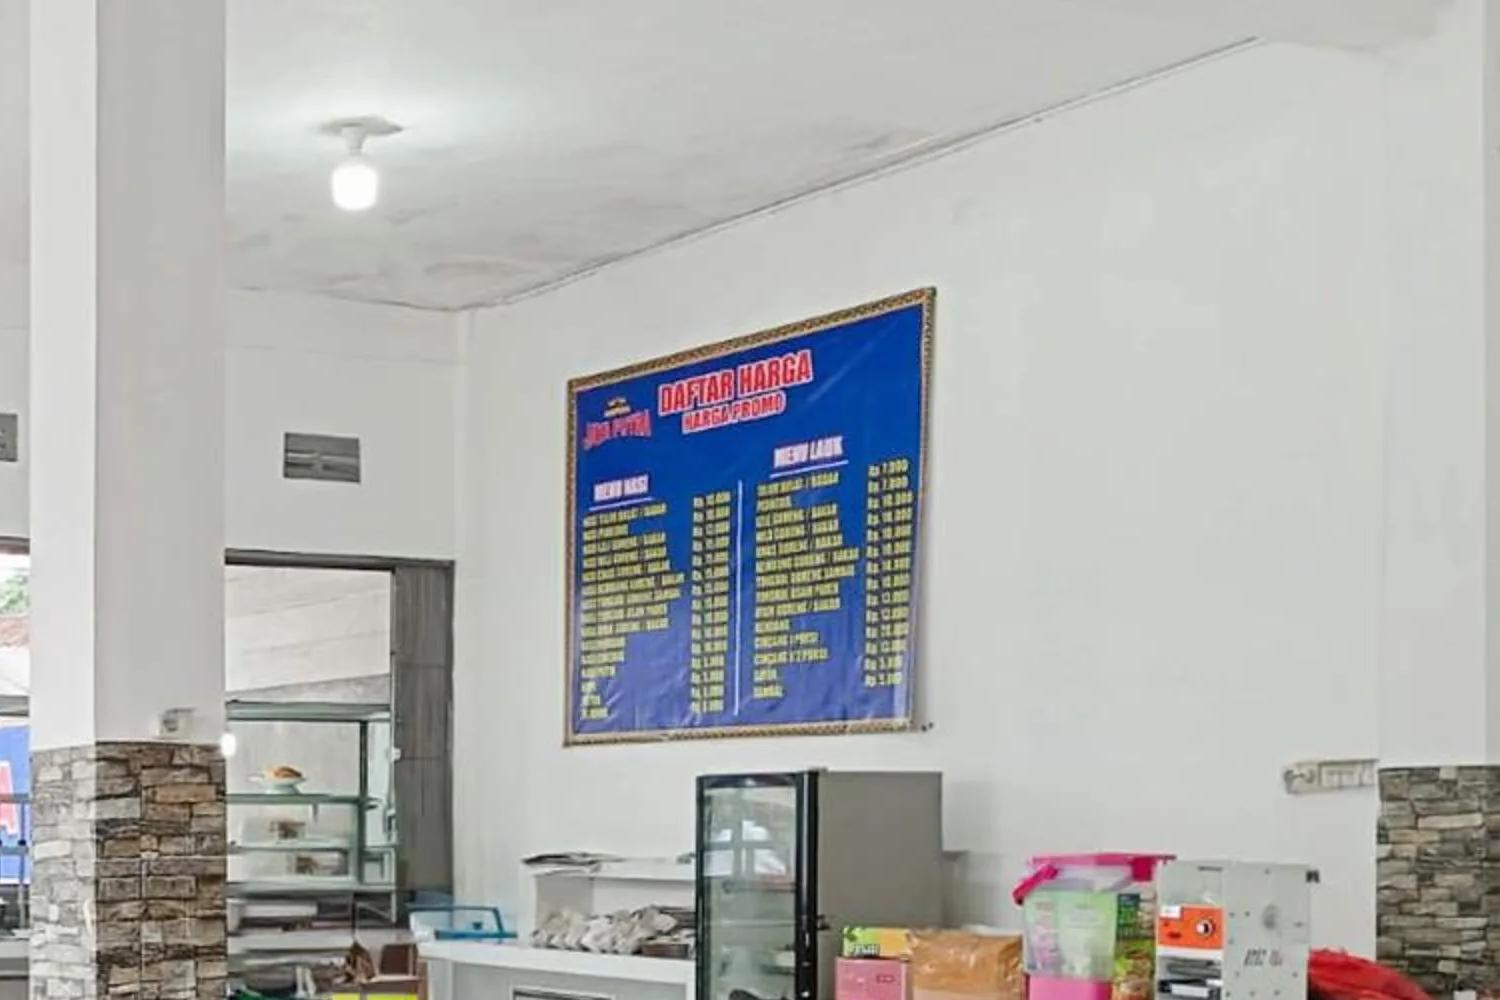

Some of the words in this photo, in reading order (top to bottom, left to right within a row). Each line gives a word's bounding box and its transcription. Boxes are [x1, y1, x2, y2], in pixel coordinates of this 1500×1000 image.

[658, 369, 734, 416] DAFTAR
[737, 350, 813, 398] HARGA
[682, 400, 729, 434] HARGA
[730, 390, 786, 425] PROMO
